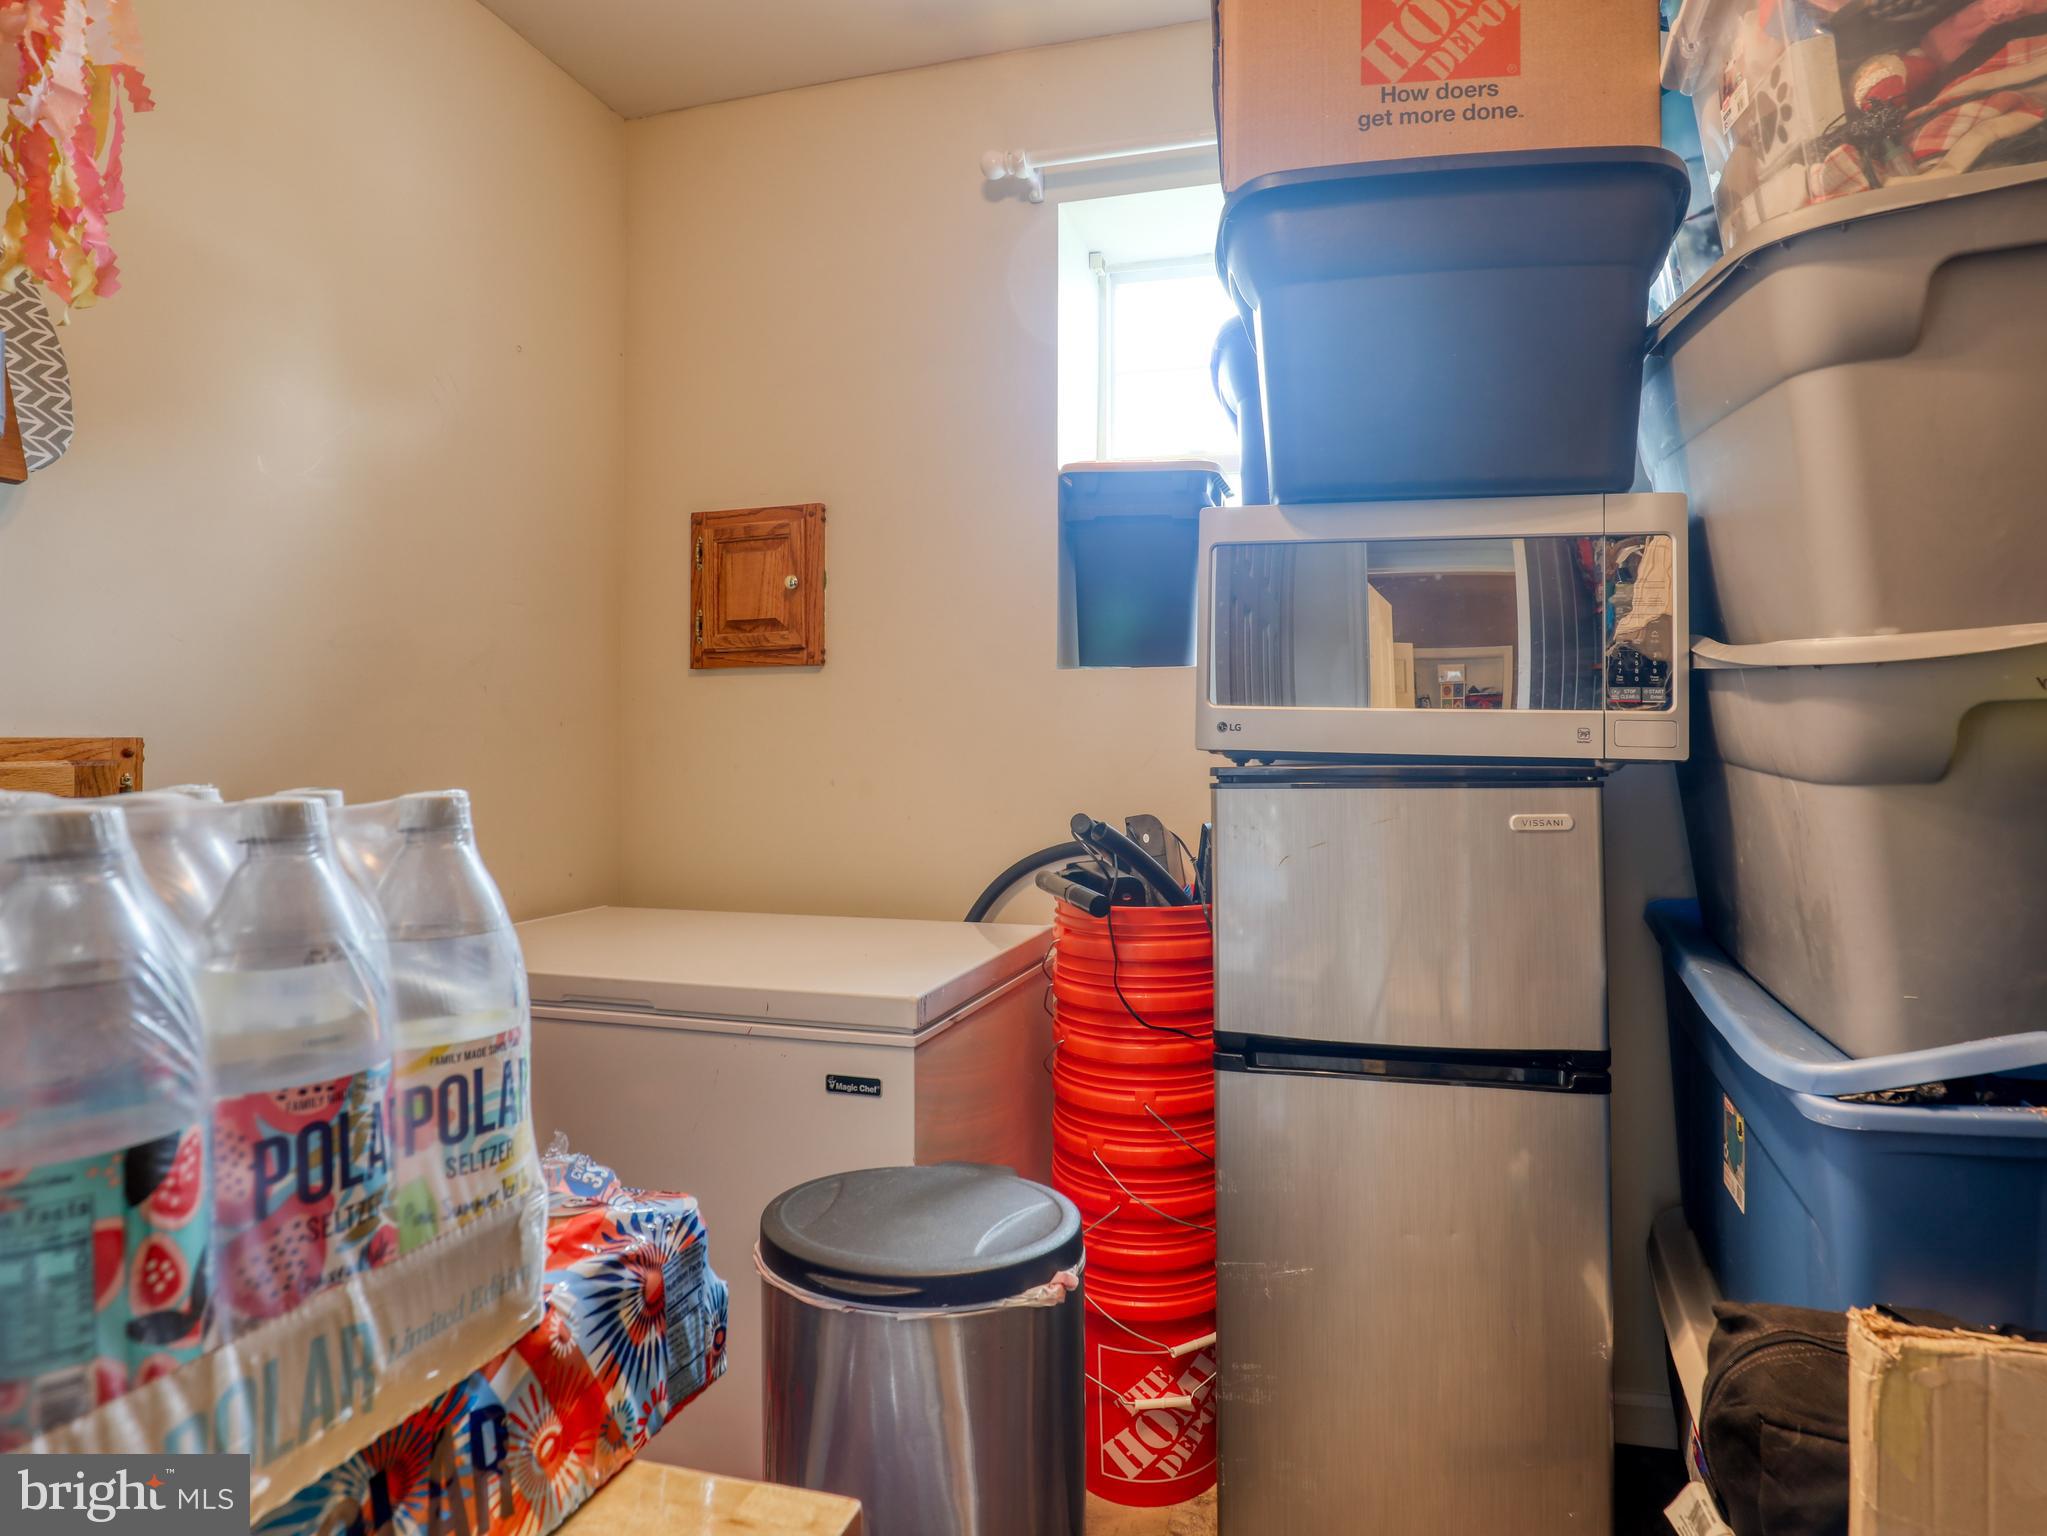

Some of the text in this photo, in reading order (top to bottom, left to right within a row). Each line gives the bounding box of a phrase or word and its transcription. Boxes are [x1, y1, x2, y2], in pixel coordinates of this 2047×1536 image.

[1423, 0, 1520, 80] DEPO
[1381, 83, 1499, 104] How doers
[1358, 110, 1392, 132] get
[1400, 108, 1456, 125] more
[1229, 723, 1242, 732] LG
[1522, 819, 1564, 828] VISSANI
[429, 1053, 462, 1066] FAMILY
[464, 1047, 487, 1061] MADE
[835, 1082, 878, 1094] Magic Chef
[1156, 1402, 1216, 1479] DEPO
